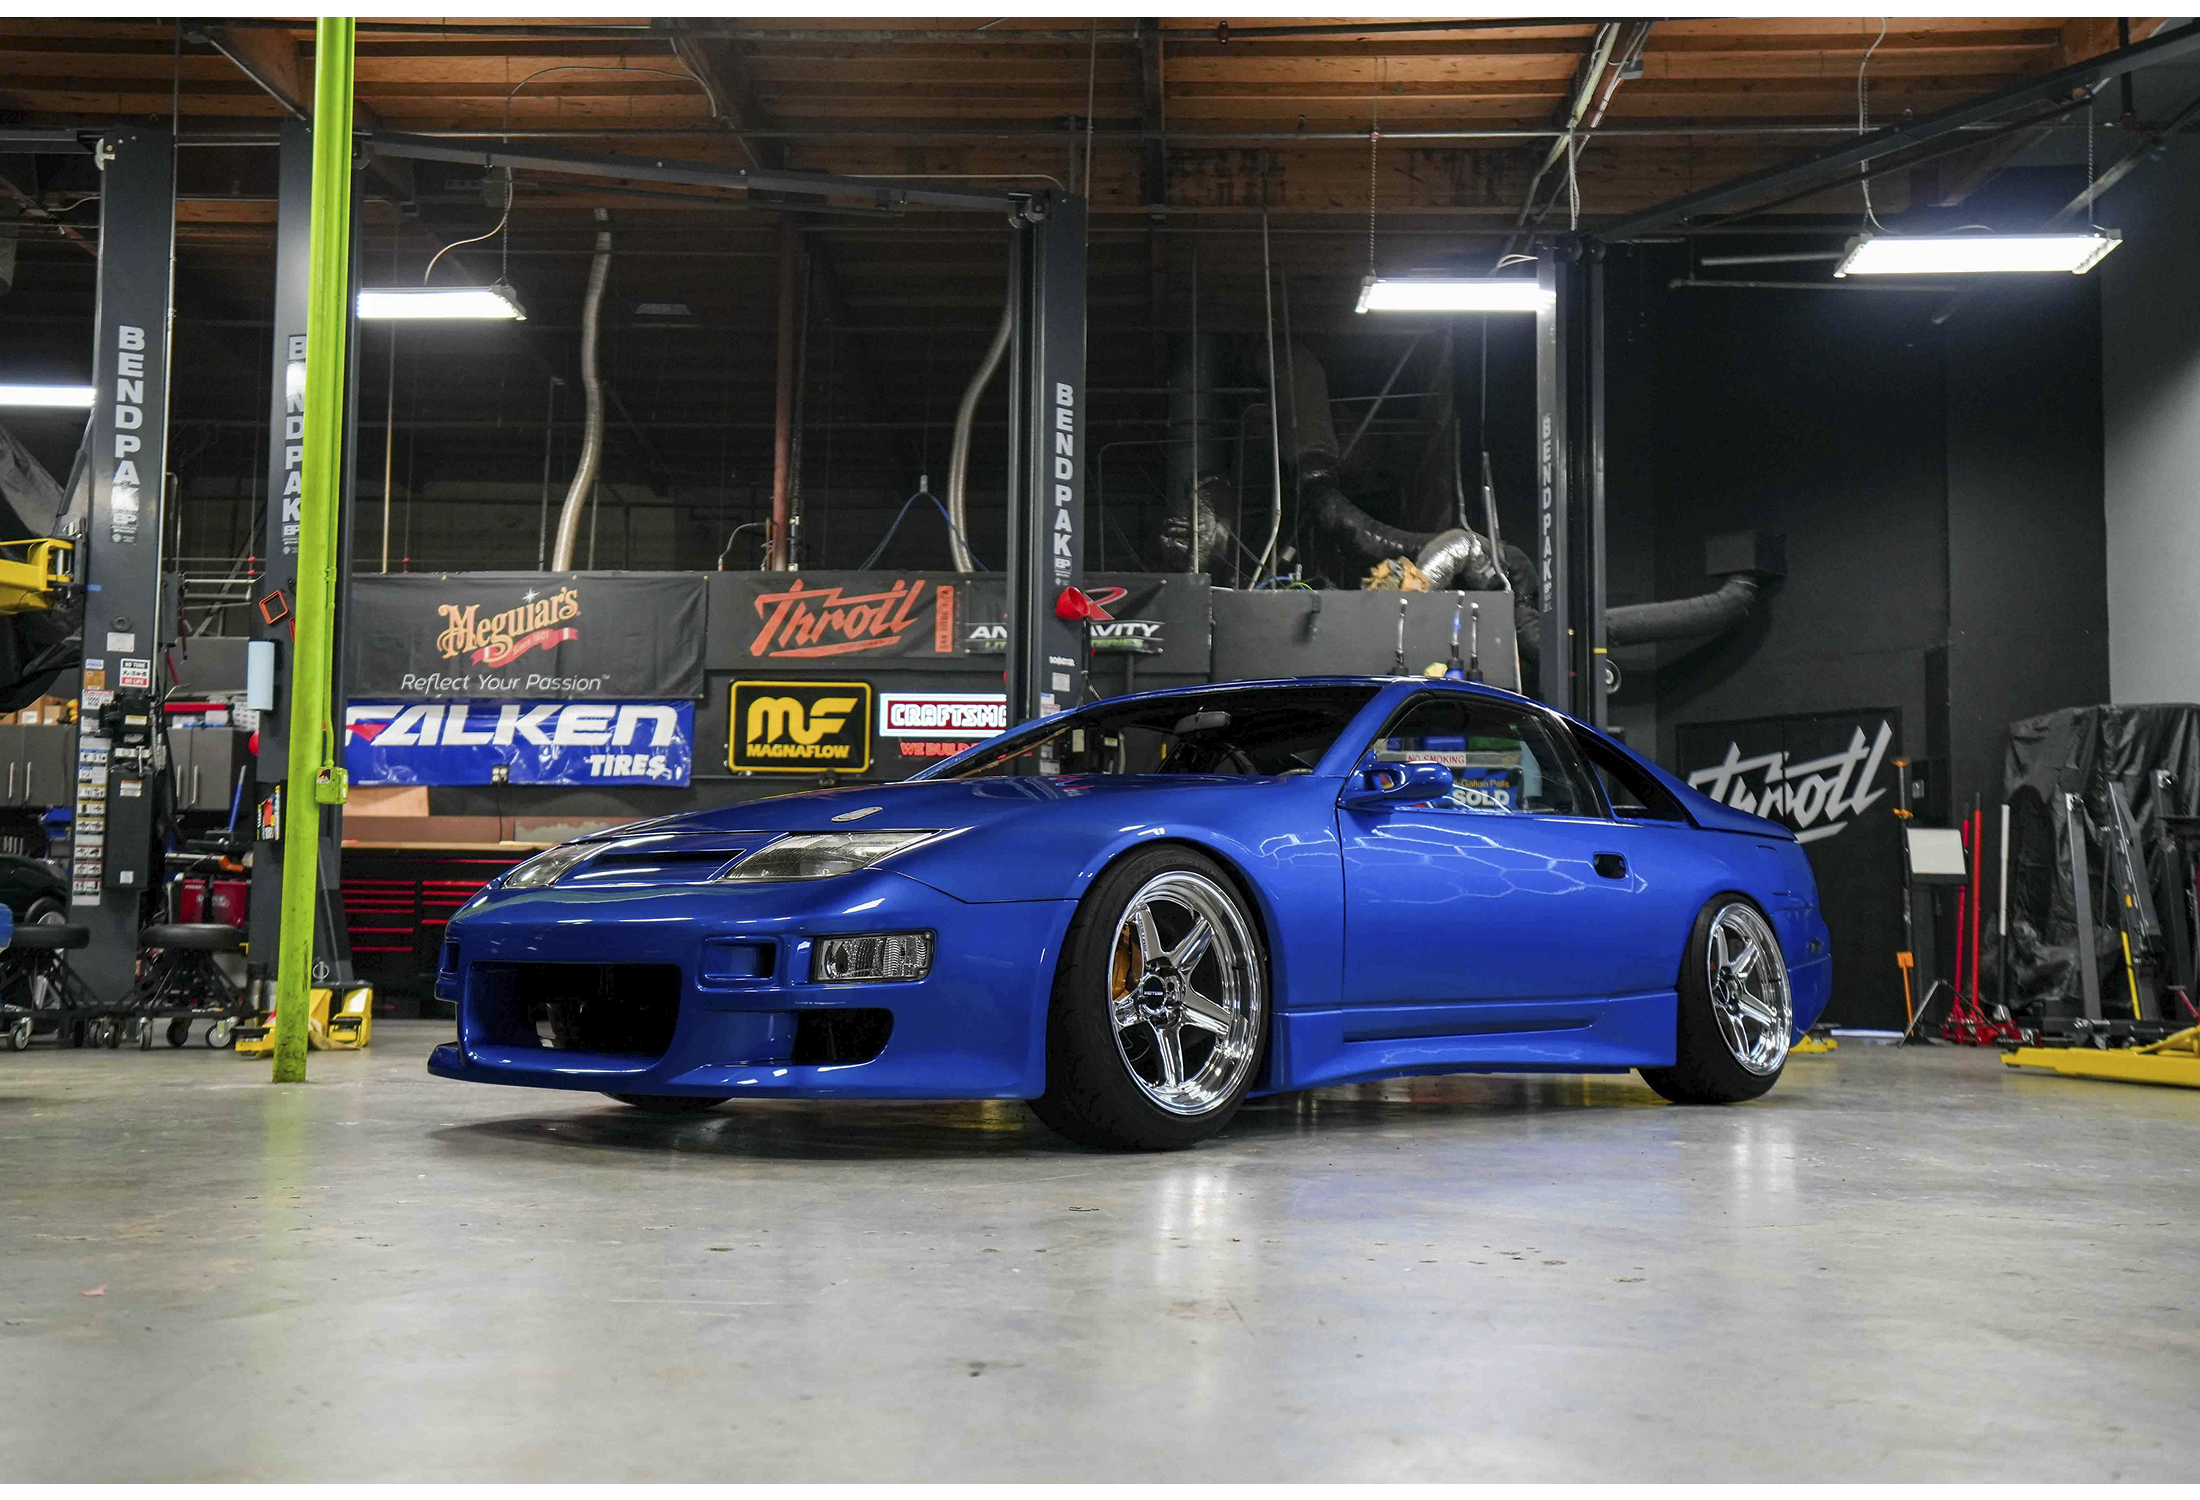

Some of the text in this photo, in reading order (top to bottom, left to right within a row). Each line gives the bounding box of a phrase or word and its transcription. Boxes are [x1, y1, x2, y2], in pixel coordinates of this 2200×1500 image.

[283, 335, 307, 522] BNDPAK
[1053, 382, 1074, 557] BENDPAK
[1543, 415, 1553, 581] BENDPAK
[437, 586, 581, 663] Meguiar's
[401, 672, 470, 695] Reflect
[478, 674, 521, 691] Your
[345, 704, 678, 746] FALKEN
[891, 703, 1006, 728] CRAFTSM
[747, 742, 850, 759] MAGNAFLOW
[900, 742, 925, 756] WE
[1423, 755, 1465, 764] SMOKING
[590, 753, 667, 778] TIRES
[1452, 789, 1510, 806] SOLD
